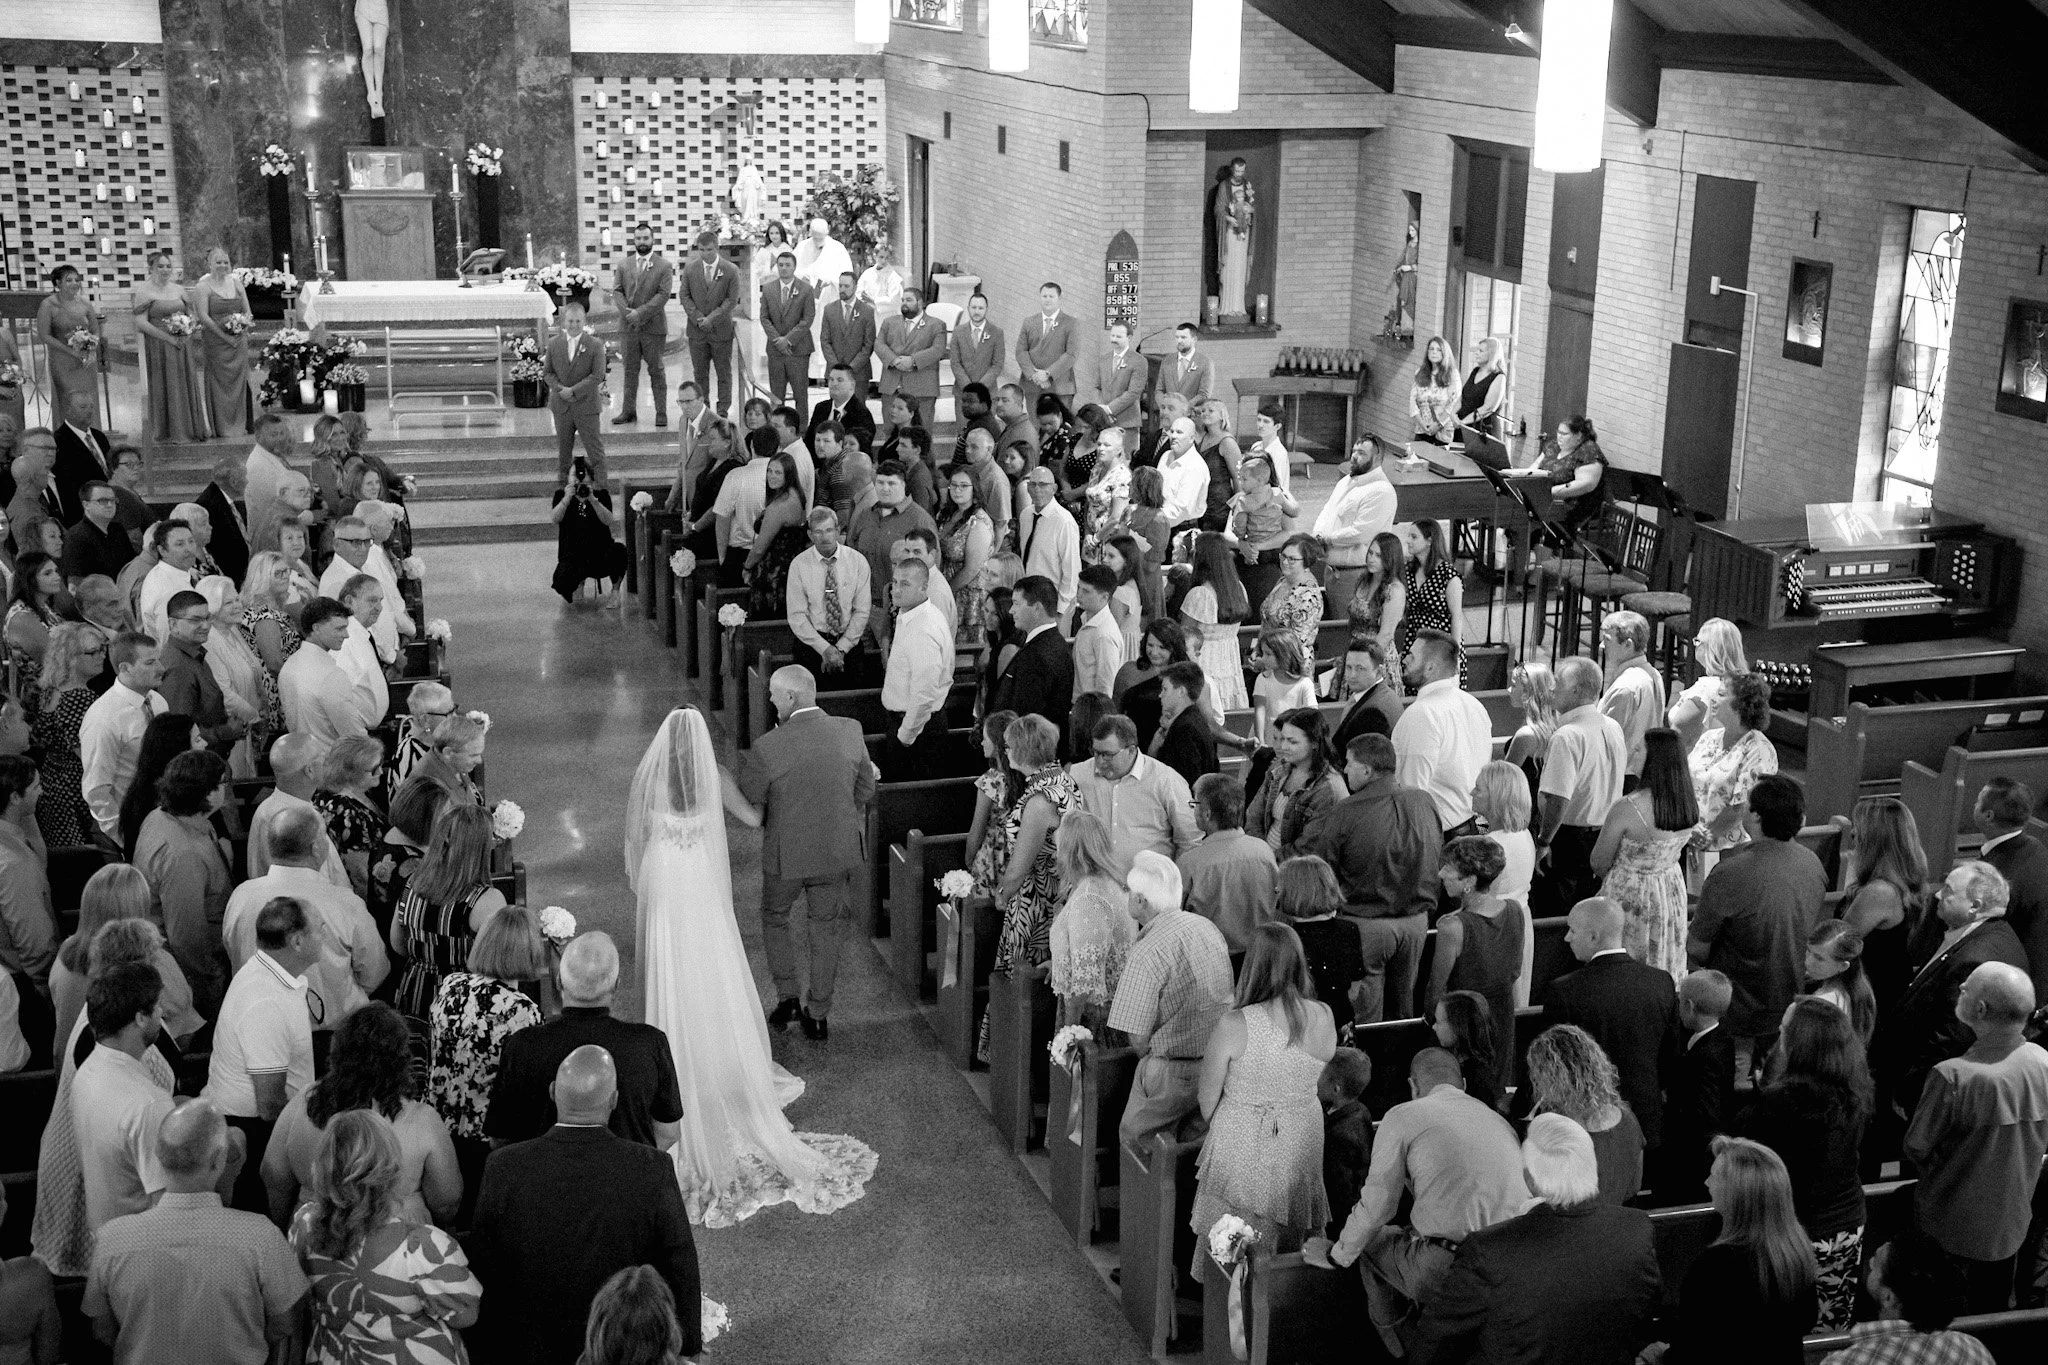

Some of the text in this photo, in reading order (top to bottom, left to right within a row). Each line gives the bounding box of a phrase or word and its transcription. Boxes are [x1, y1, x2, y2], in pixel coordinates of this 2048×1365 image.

[1122, 262, 1139, 271] 536
[1113, 273, 1130, 282] 855
[1107, 284, 1138, 294] OFF 577
[1106, 306, 1138, 316] COM 390
